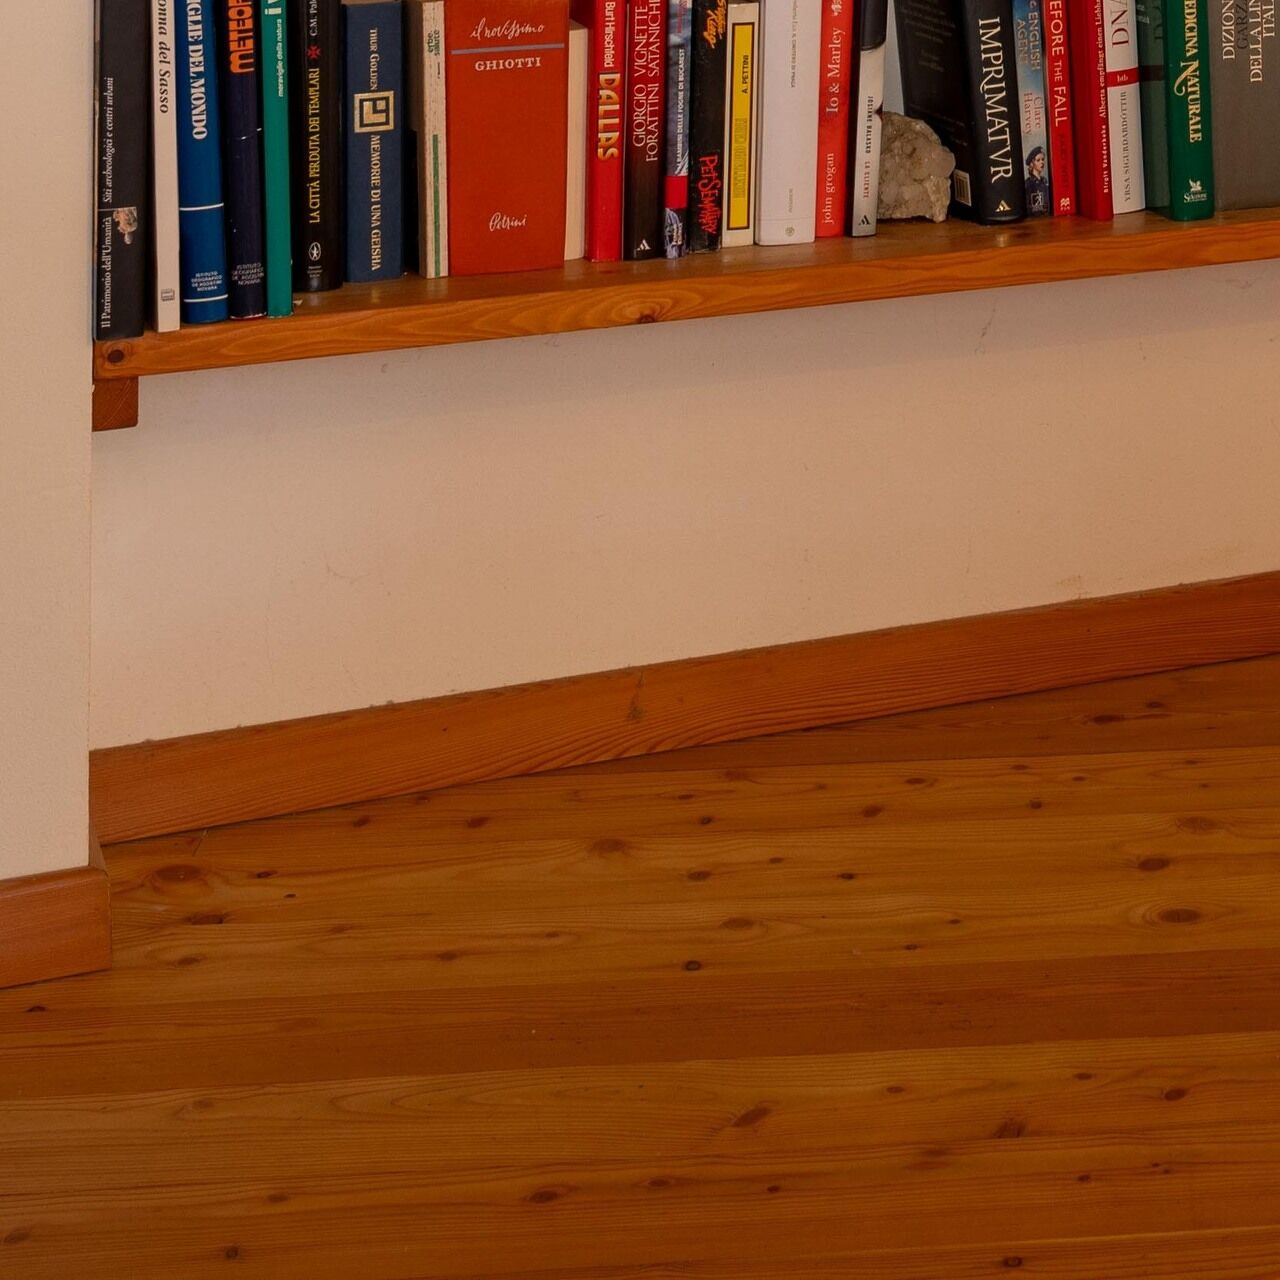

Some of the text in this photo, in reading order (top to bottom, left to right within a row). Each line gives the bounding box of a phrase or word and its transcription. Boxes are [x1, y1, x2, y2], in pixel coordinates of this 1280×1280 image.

[265, 7, 282, 16] i
[603, 1, 616, 68] Burt Hirschfeld
[158, 41, 171, 64] del
[275, 41, 283, 60] della
[474, 57, 542, 72] GHIOTTI
[1027, 11, 1041, 71] ENGLISH
[1248, 23, 1263, 82] DELLA
[158, 66, 170, 114] Sasso
[275, 60, 284, 97] meraviglie
[632, 4, 649, 147] GIORGIO VIGNETTE
[741, 54, 749, 94] A. PETTINI
[1053, 61, 1063, 82] THE
[645, 79, 660, 162] FORATTINI
[978, 16, 1014, 184] IMPRIMATVR
[1023, 92, 1034, 136] Harvey
[1032, 96, 1043, 129] Clare
[1054, 85, 1068, 128] FALL
[1174, 60, 1203, 144] NATURALE
[307, 67, 320, 224] LA CITTÀ PERDUTA DEI TEMPLARI
[370, 134, 382, 271] MEMORIE DI UNA GEISHA
[823, 153, 836, 225] john grogan
[101, 216, 112, 329] Il Patrimonio dell'Umanità
